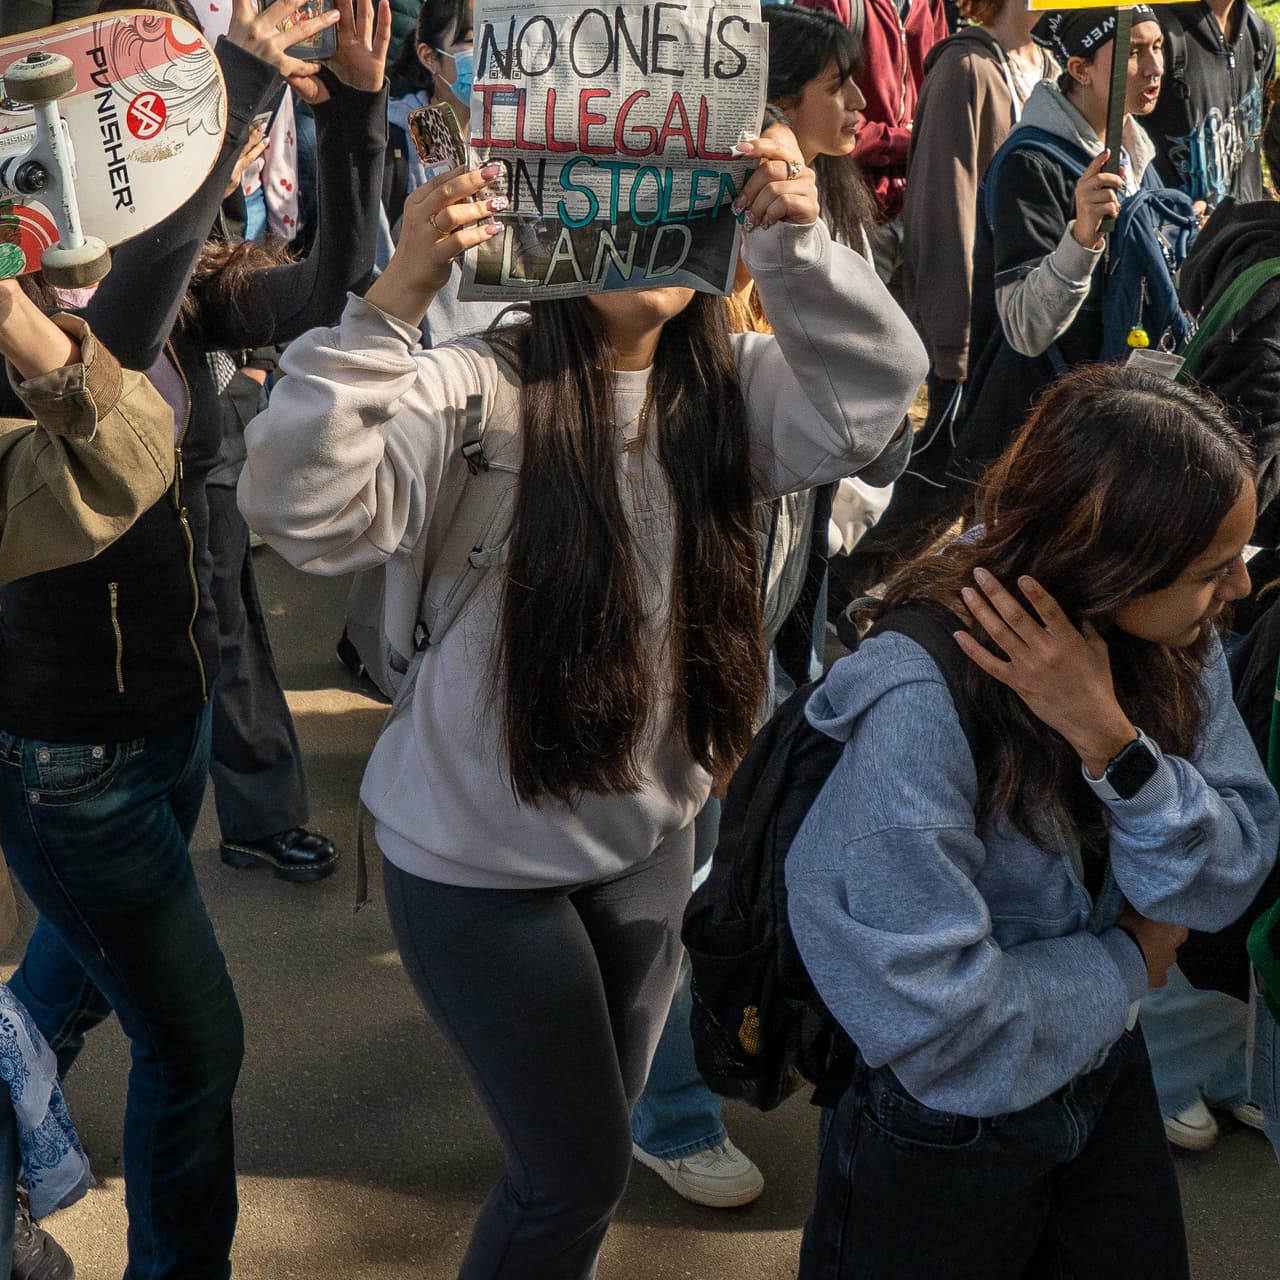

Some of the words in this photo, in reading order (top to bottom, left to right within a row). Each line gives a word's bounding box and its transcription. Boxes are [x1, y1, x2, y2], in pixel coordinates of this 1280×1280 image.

[477, 14, 557, 81] NO
[569, 1, 688, 79] ONE
[704, 6, 750, 80] IS
[86, 46, 134, 212] PUNISHER
[467, 84, 739, 160] ILLEGAL
[557, 155, 753, 229] STOLEN
[499, 223, 693, 289] LAND
